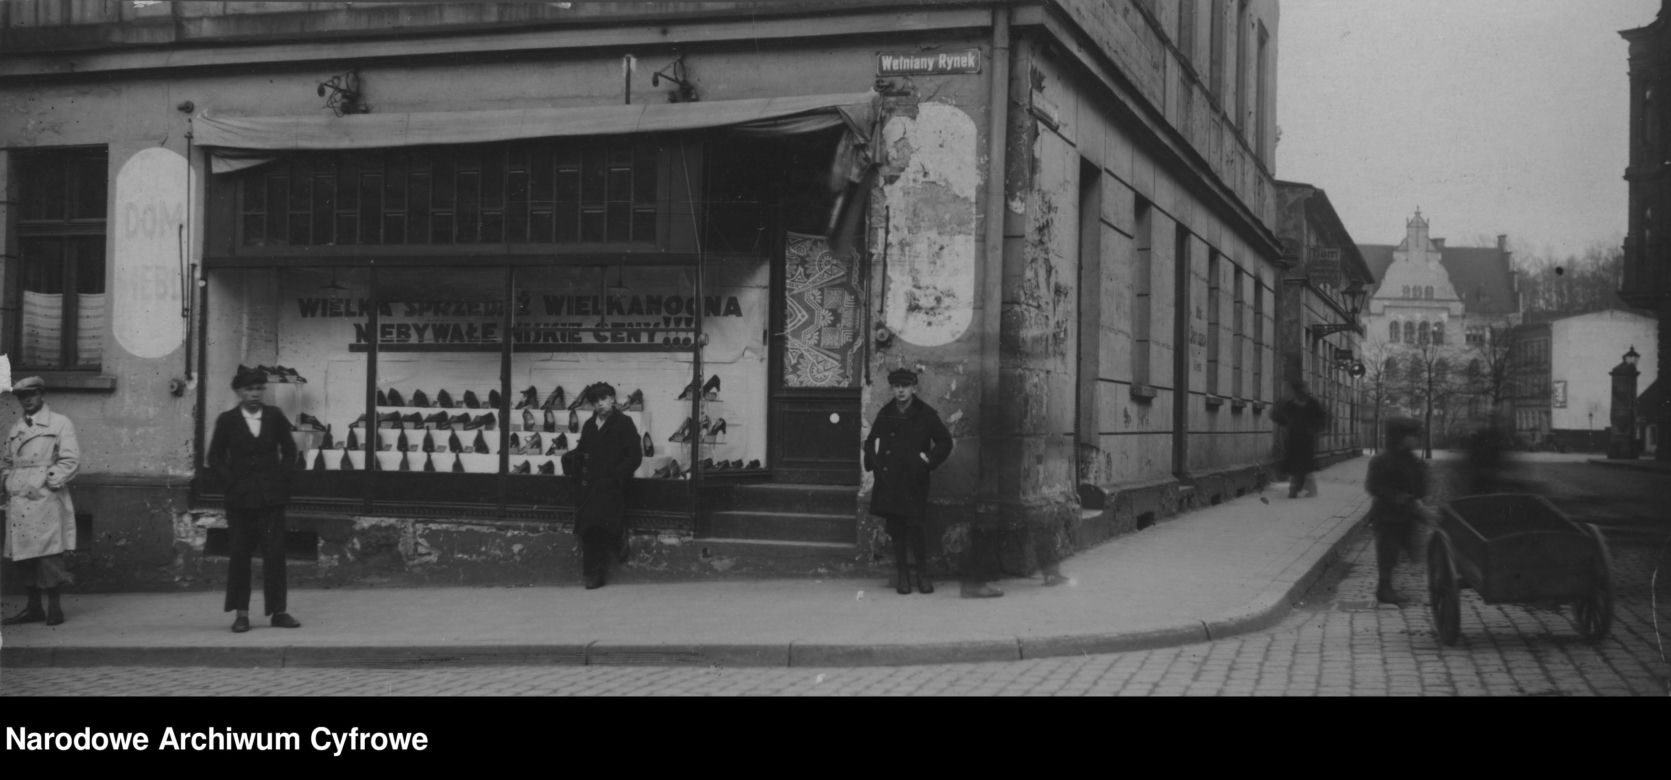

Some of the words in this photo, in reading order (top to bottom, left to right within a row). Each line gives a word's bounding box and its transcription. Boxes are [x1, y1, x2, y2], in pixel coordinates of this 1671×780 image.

[938, 51, 976, 71] Rynek
[124, 201, 183, 240] DOM
[297, 297, 393, 318] WIELKA
[353, 321, 498, 344] NEBYWAŁE
